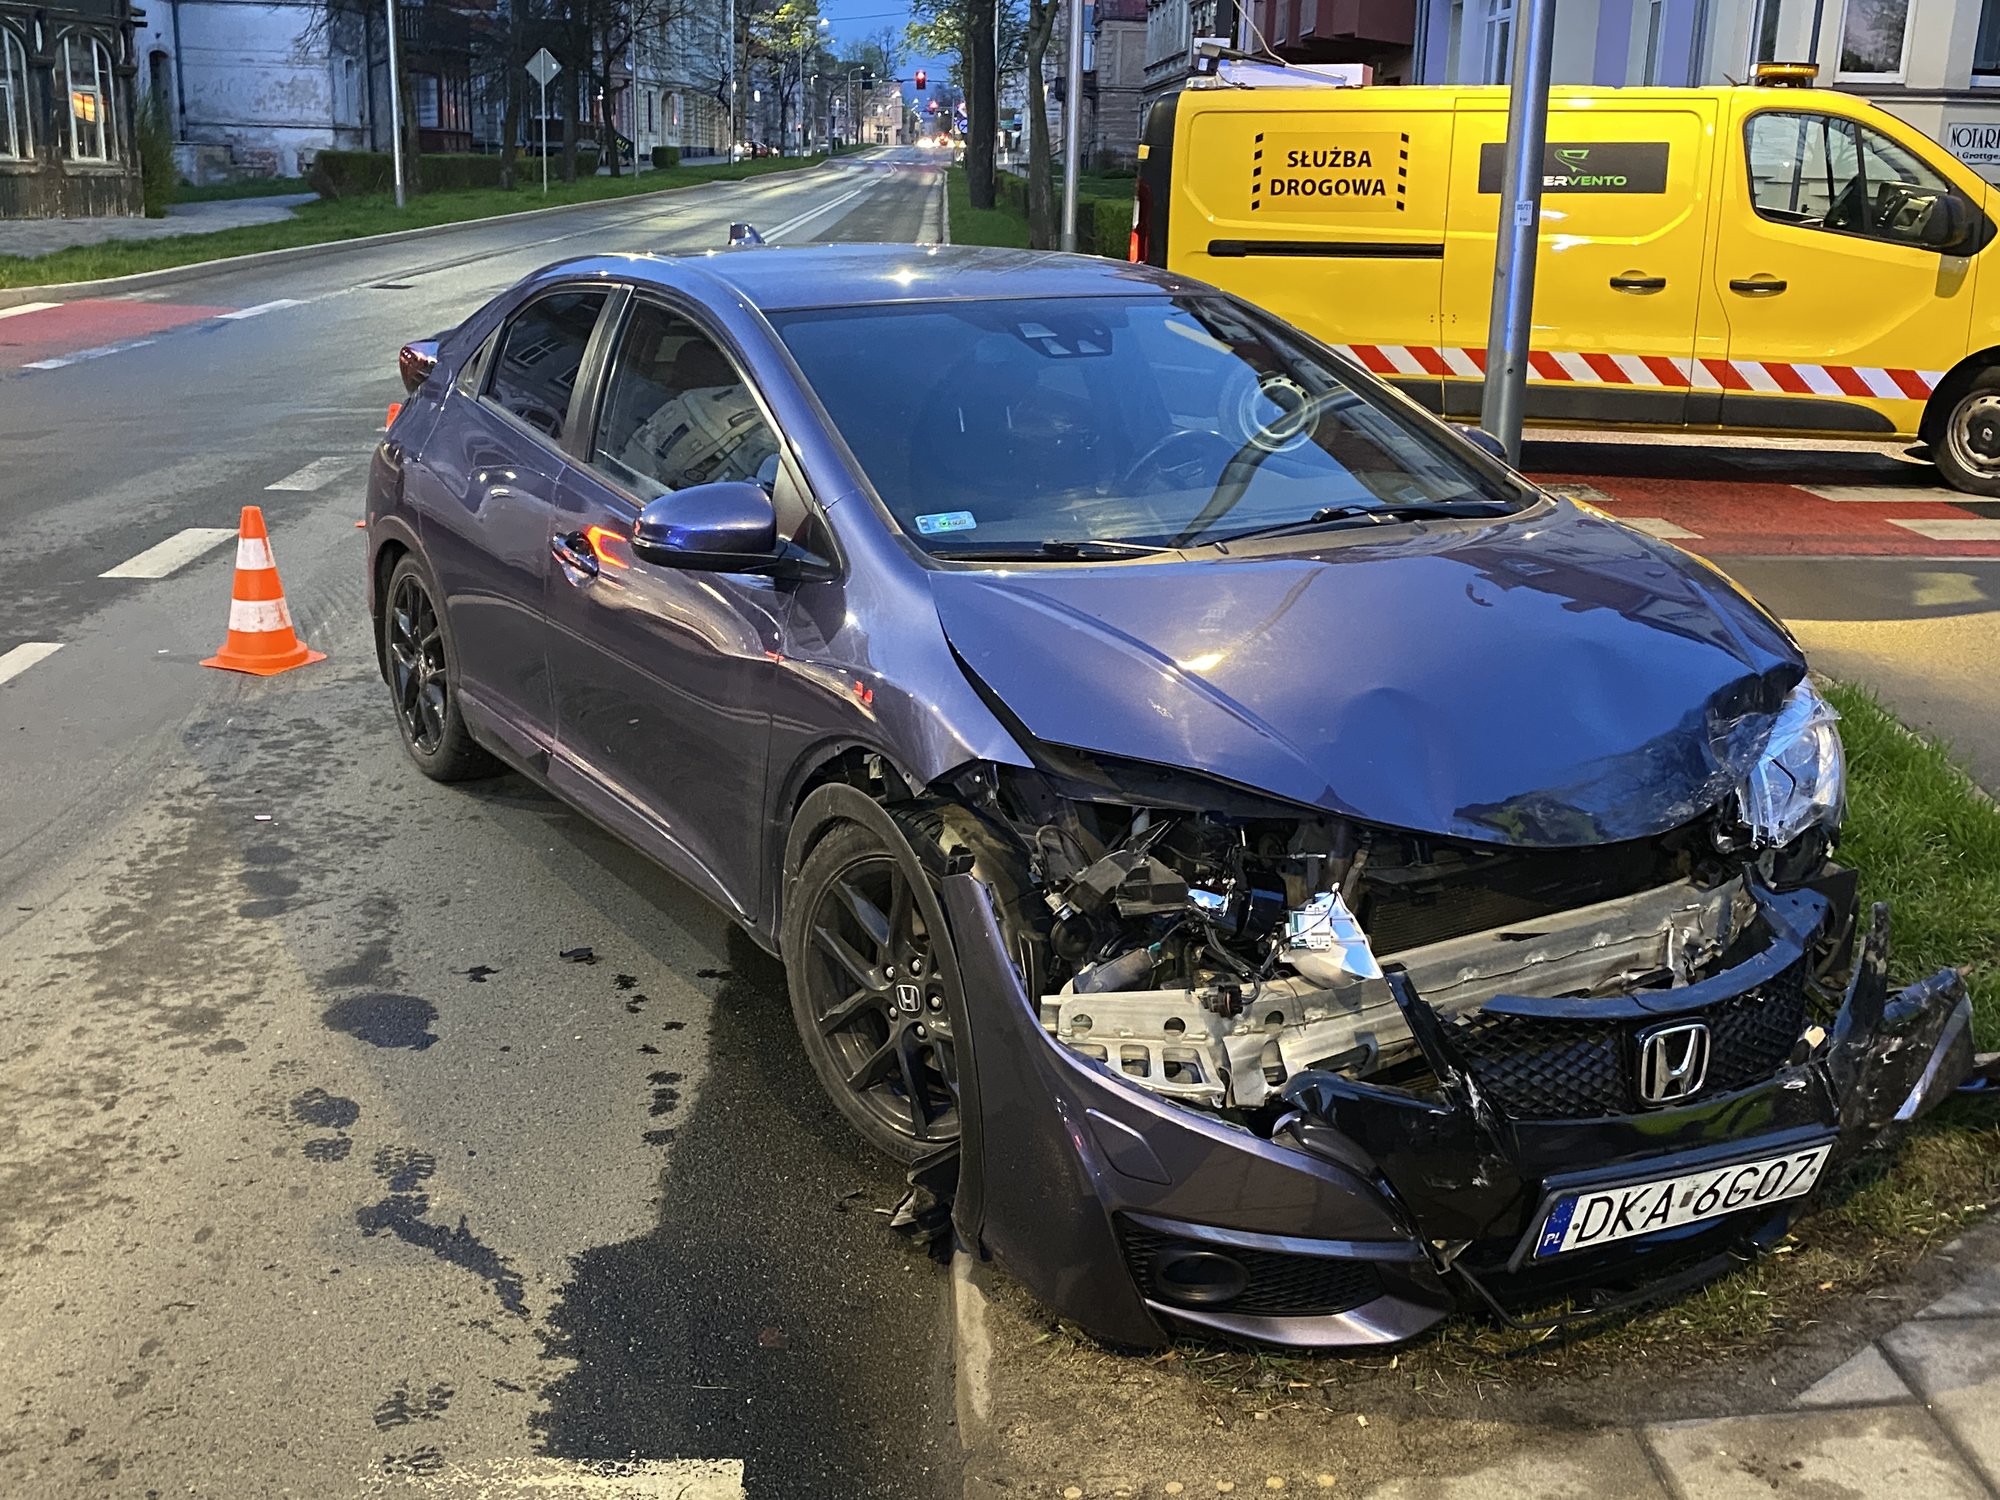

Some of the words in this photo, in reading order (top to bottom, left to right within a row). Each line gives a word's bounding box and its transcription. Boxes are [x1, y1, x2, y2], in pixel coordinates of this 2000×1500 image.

[1287, 146, 1372, 168] SŁUŻBA
[1270, 178, 1386, 196] DROGOWA
[1542, 175, 1627, 187] ERVENTO
[1692, 1151, 1820, 1216] 6G07
[1544, 1231, 1561, 1247] PL
